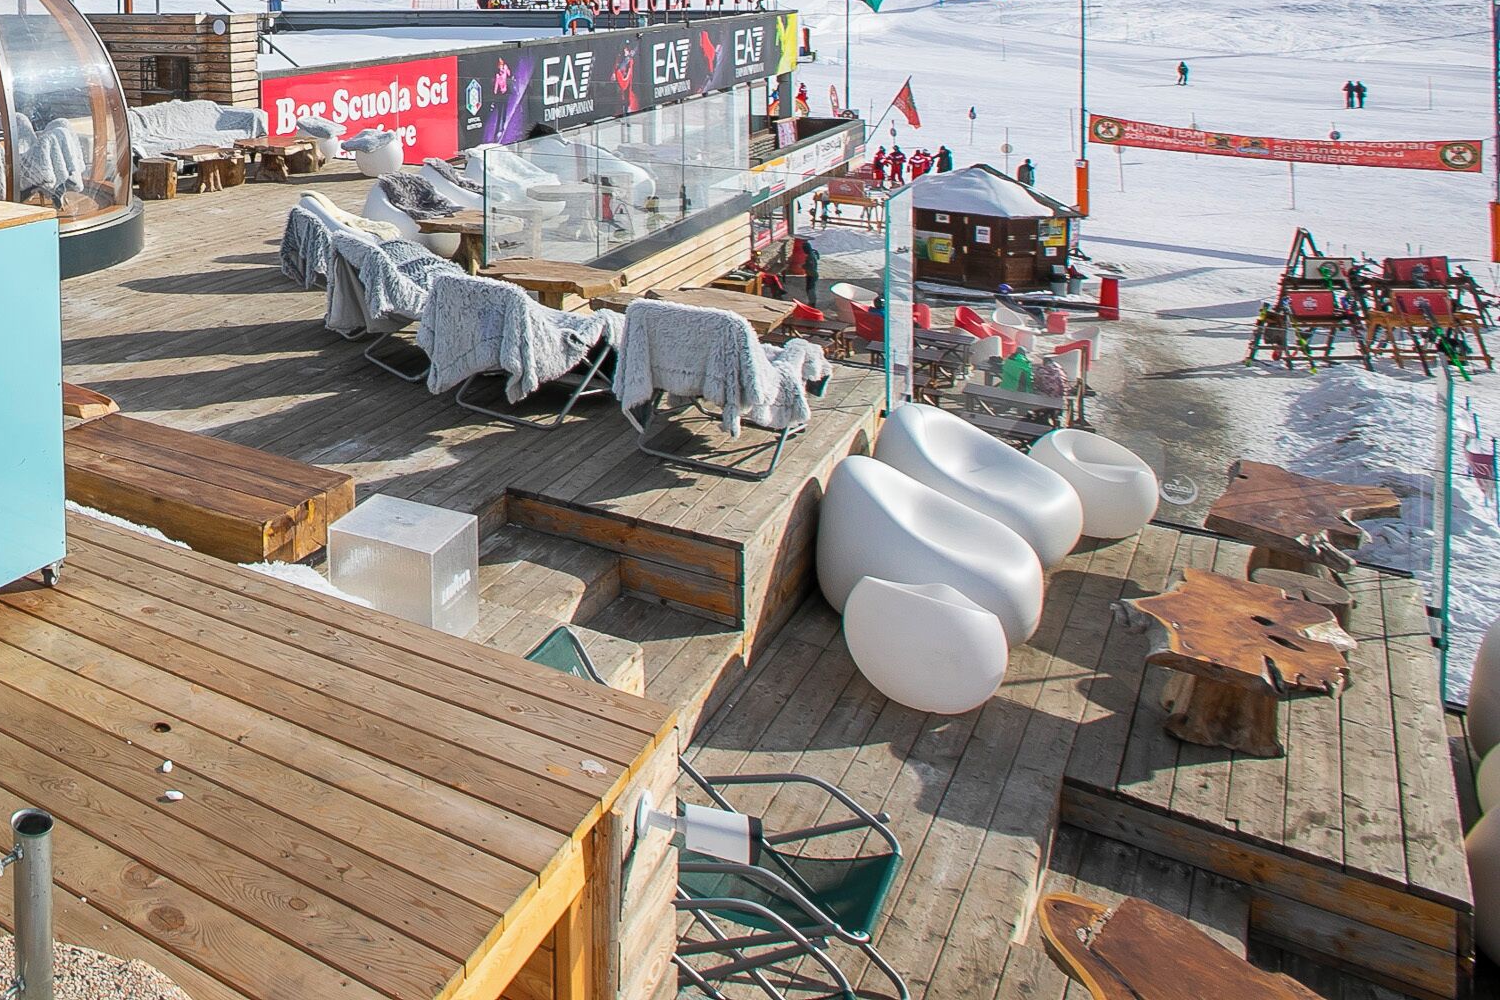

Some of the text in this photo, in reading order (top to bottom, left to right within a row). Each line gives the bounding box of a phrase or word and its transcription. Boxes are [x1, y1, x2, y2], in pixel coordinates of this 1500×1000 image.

[652, 38, 690, 84] EA7
[734, 26, 765, 66] EA7
[542, 50, 594, 106] EA7
[275, 73, 449, 136] Bar Scuola Sci
[1123, 122, 1205, 141] JUNIOR TEAM
[1273, 151, 1359, 164] SESTRIERE
